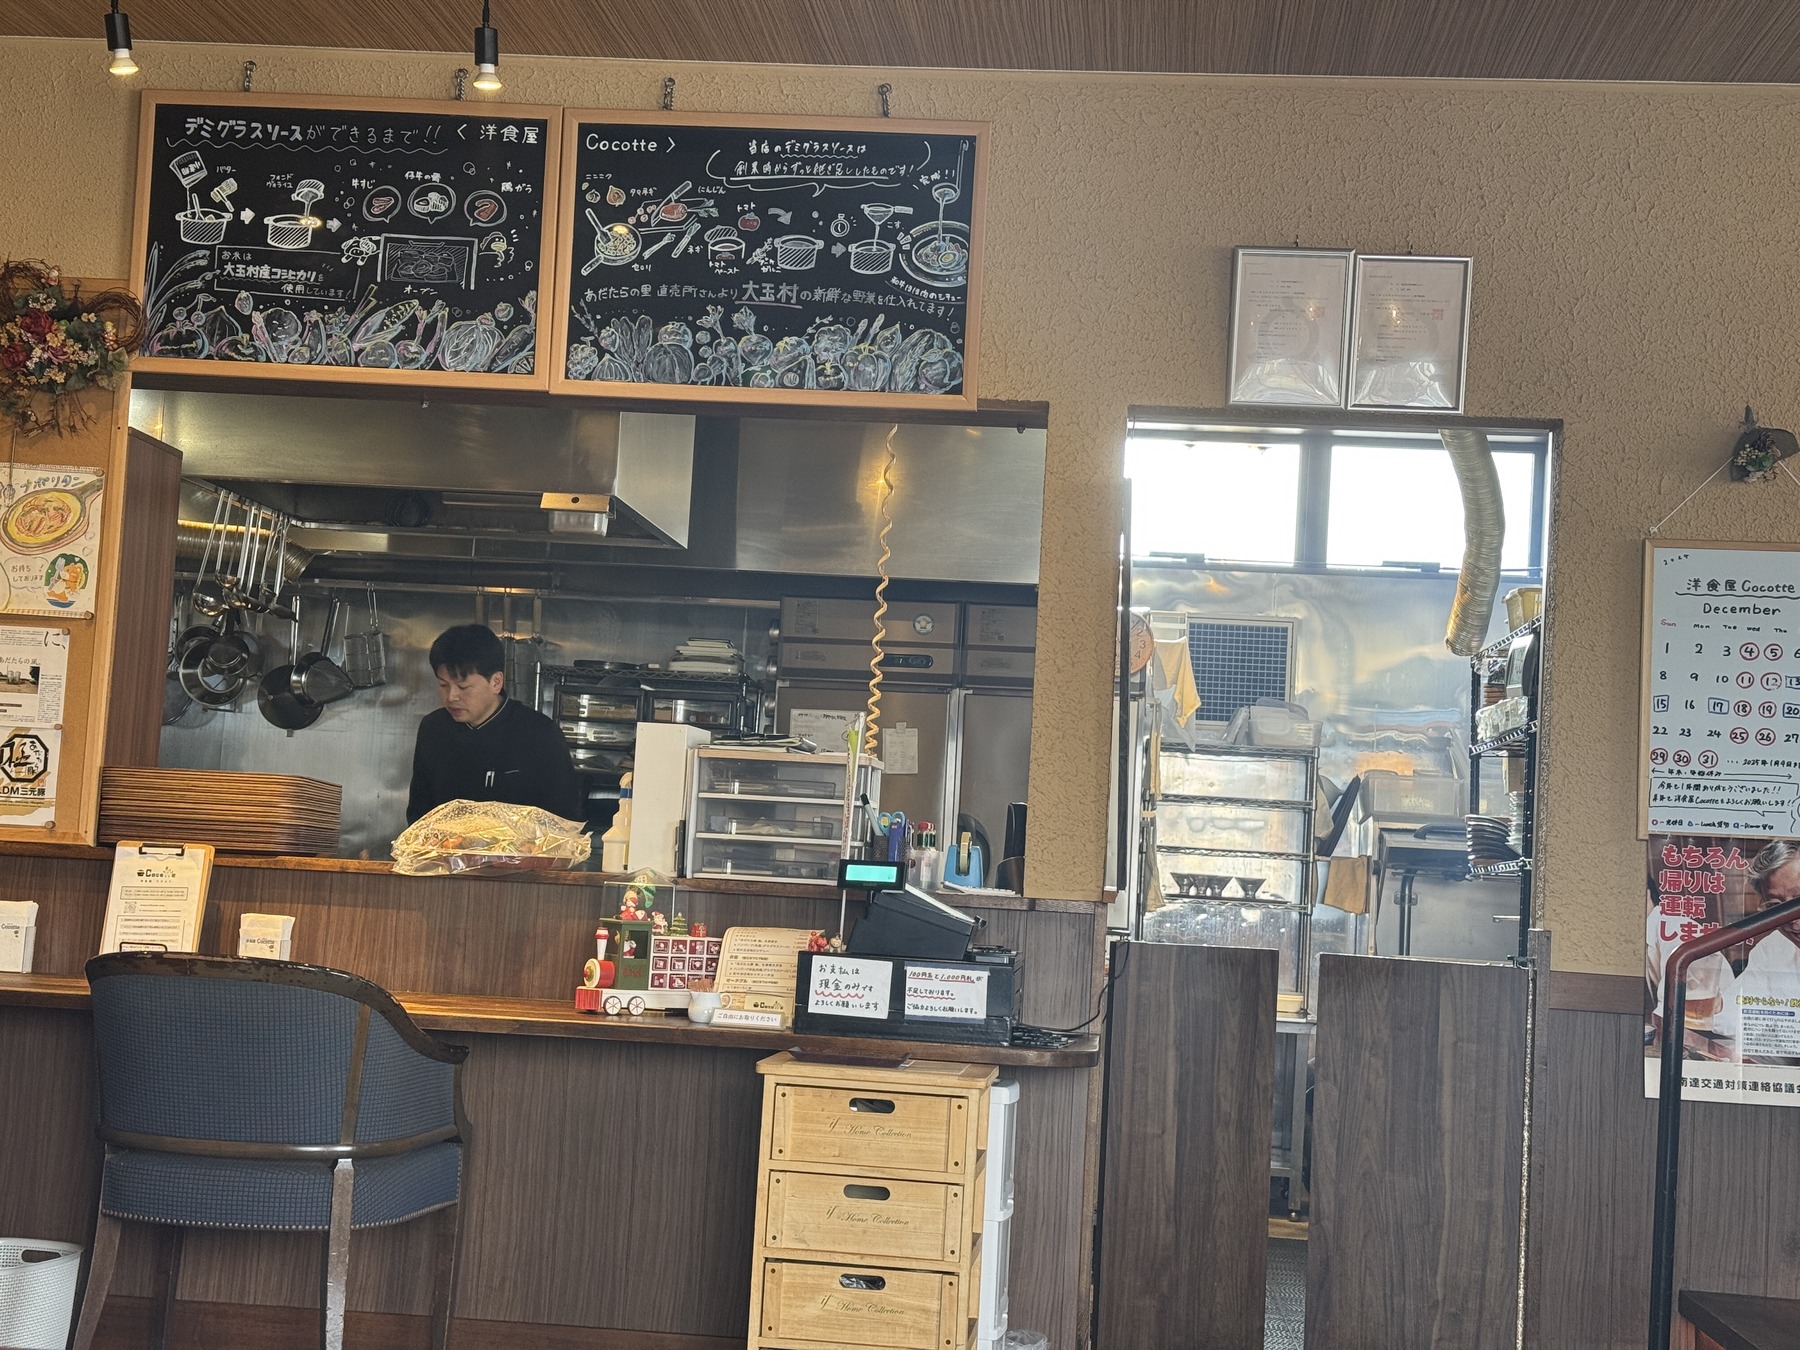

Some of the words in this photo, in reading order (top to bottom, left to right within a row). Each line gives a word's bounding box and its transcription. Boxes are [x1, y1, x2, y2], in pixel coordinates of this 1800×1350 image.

[480, 123, 539, 145] 洋食屋
[586, 133, 658, 152] Cocotte
[216, 166, 237, 174] バター
[351, 178, 376, 190] 牛すじ
[698, 185, 727, 195] にんじん
[736, 201, 757, 213] トマト
[686, 244, 704, 255] ネギ
[709, 260, 727, 268] トマト
[403, 284, 439, 295] オーブン
[1703, 602, 1782, 616] December
[1660, 619, 1677, 628] Sun
[1694, 643, 1703, 654] 2
[1722, 645, 1732, 657] 3
[1659, 670, 1668, 681] 8
[1690, 672, 1699, 682] 9
[1715, 675, 1729, 684] 10
[1740, 676, 1752, 685] 11
[1656, 698, 1667, 709] 15
[1684, 699, 1695, 710] 16
[1712, 701, 1724, 712] 17
[1737, 703, 1748, 714] 18
[1762, 704, 1773, 715] 19
[1785, 706, 1800, 716] 20
[1652, 725, 1669, 736] 22
[1679, 728, 1692, 738] 23
[1706, 729, 1722, 739] 24
[1731, 731, 1745, 741] 25
[1758, 732, 1772, 742] 26
[1783, 733, 1800, 744] 27
[1652, 751, 1666, 762] 29
[1674, 753, 1689, 764] 30
[1702, 754, 1714, 766] 31
[1662, 844, 1750, 870] もちろん
[1659, 870, 1727, 895] 帰りは
[1659, 895, 1707, 919] 運転
[819, 963, 860, 976] お支払は
[819, 978, 874, 993] 現金のみです
[814, 999, 879, 1011] よろしくお願いします
[874, 1124, 912, 1138] Collection
[871, 1212, 910, 1226] Collection
[866, 1302, 904, 1315] Collection
